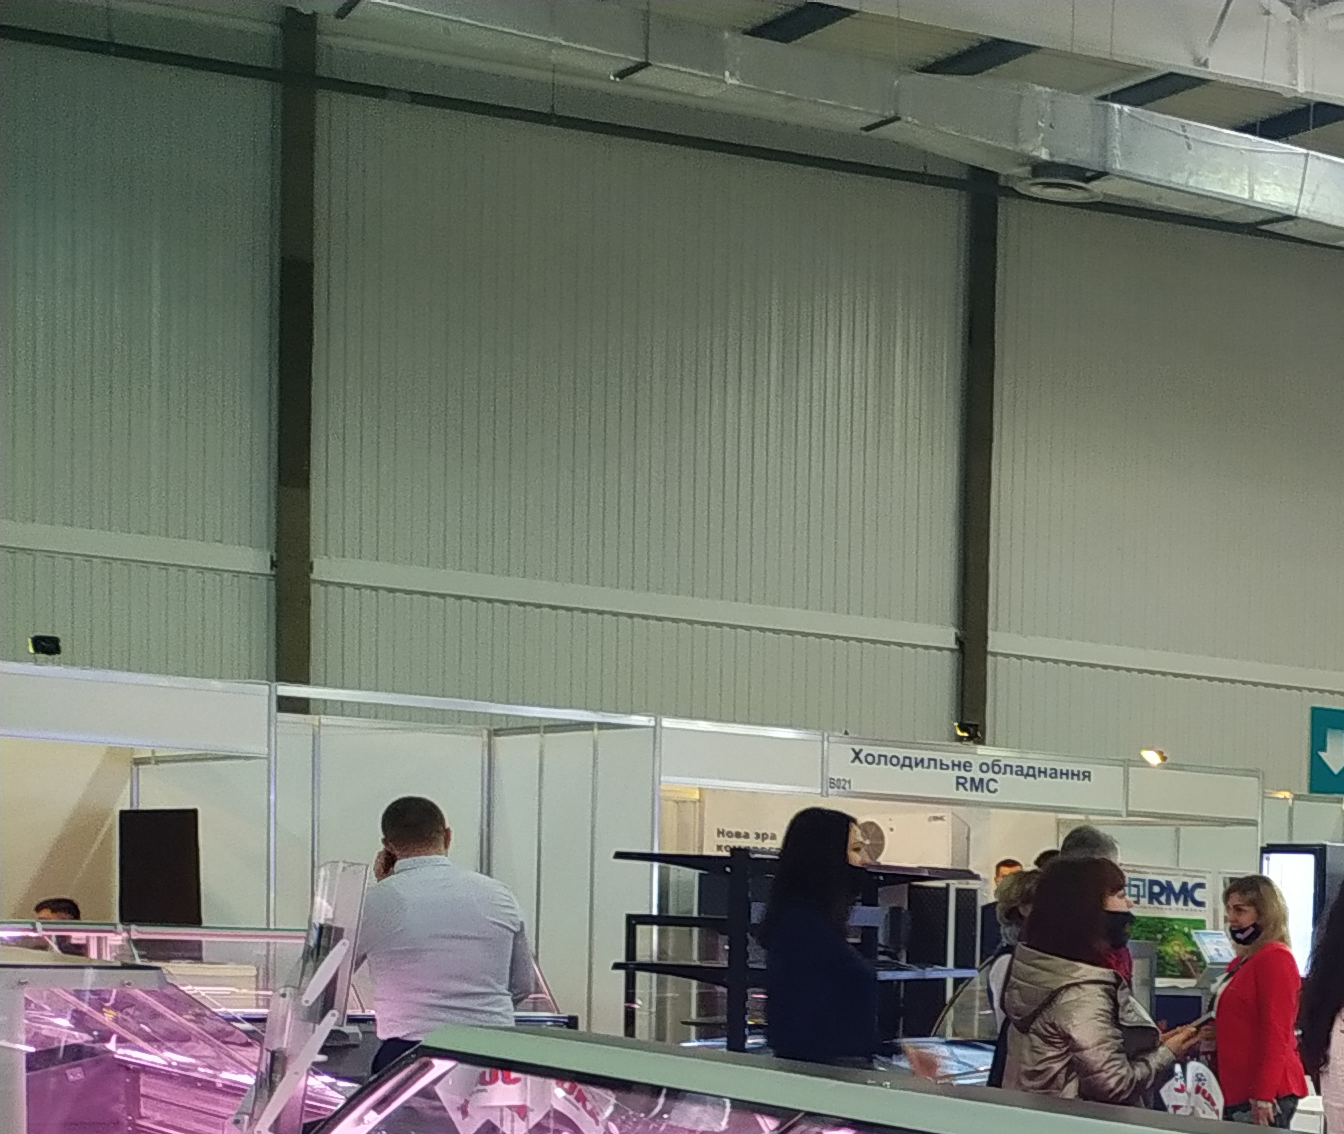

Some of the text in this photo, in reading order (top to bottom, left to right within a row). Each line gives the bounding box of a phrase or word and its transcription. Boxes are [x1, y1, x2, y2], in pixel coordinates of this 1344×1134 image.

[850, 747, 1092, 782] Холодильне обладнання
[955, 775, 999, 795] RMC
[716, 827, 750, 840] Нова
[1147, 878, 1207, 908] RMC
